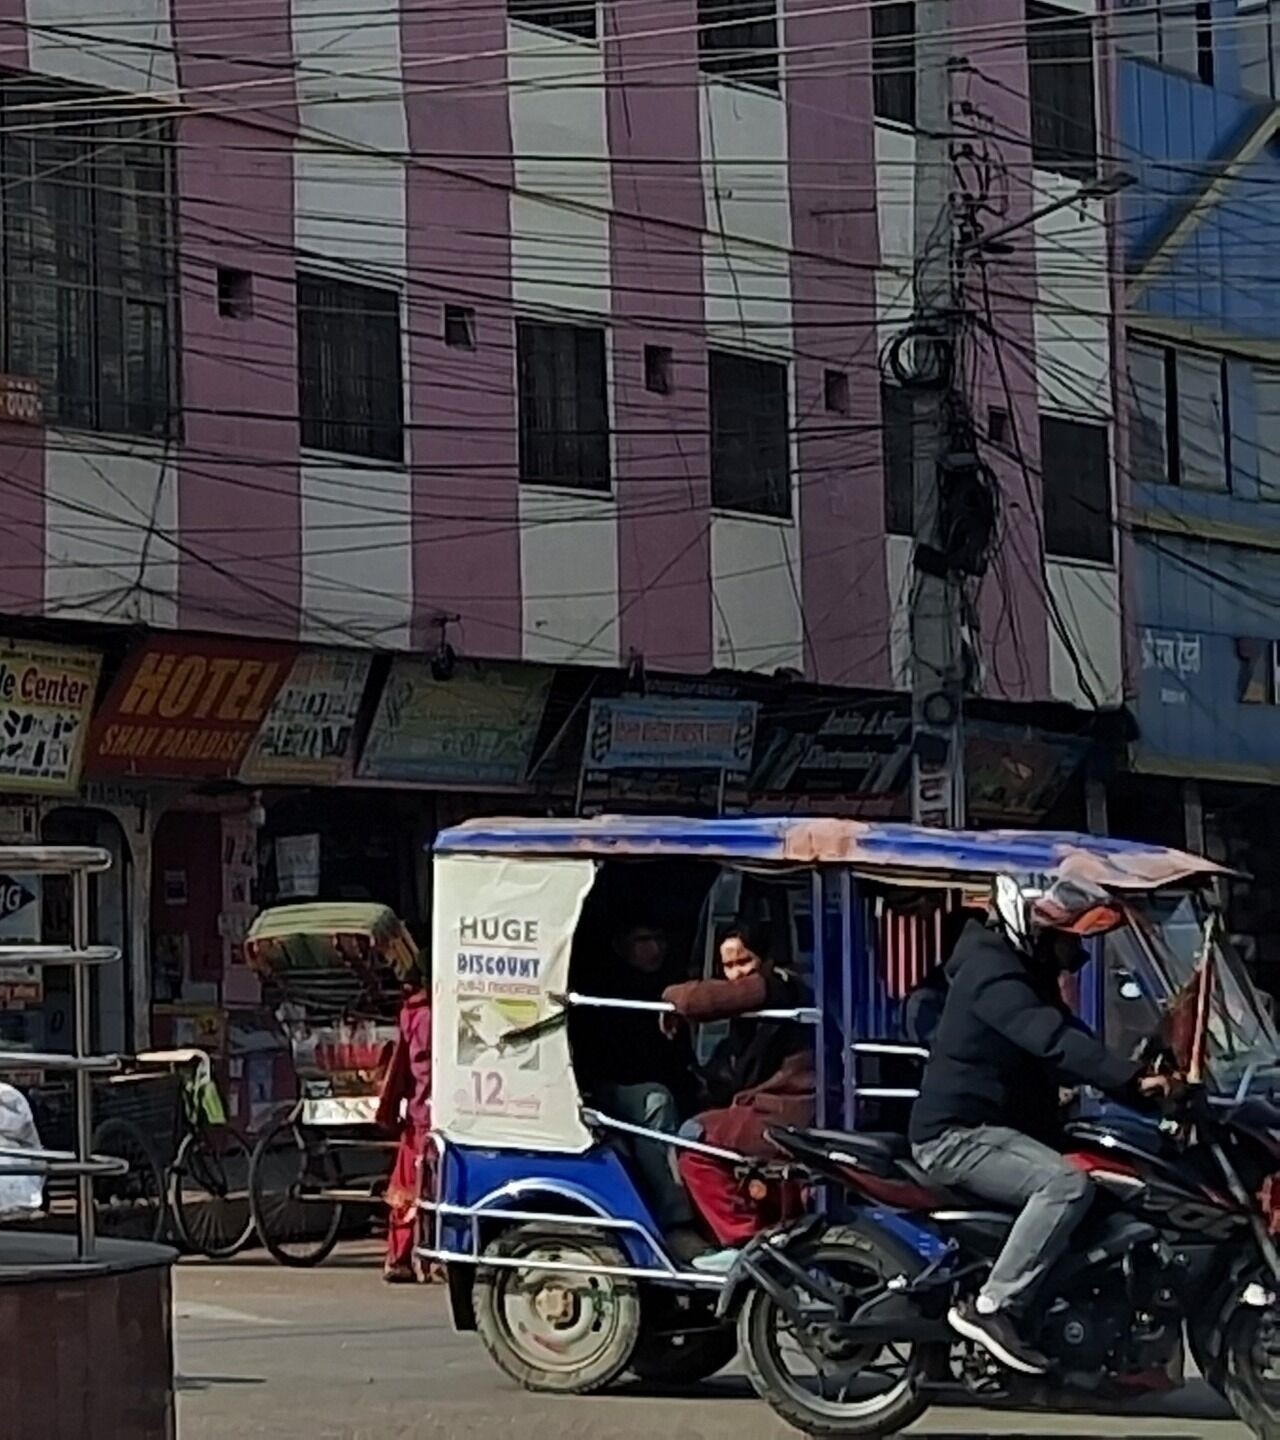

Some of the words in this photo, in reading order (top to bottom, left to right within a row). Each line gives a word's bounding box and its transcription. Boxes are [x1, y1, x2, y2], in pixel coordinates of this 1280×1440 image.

[20, 666, 89, 705] Center
[118, 651, 282, 722] HOTEL
[98, 722, 161, 757] SHAH
[154, 727, 252, 761] PARADISE
[459, 916, 538, 943] HUGE
[456, 952, 541, 979] DISCOUNT
[471, 1070, 505, 1107] 12
